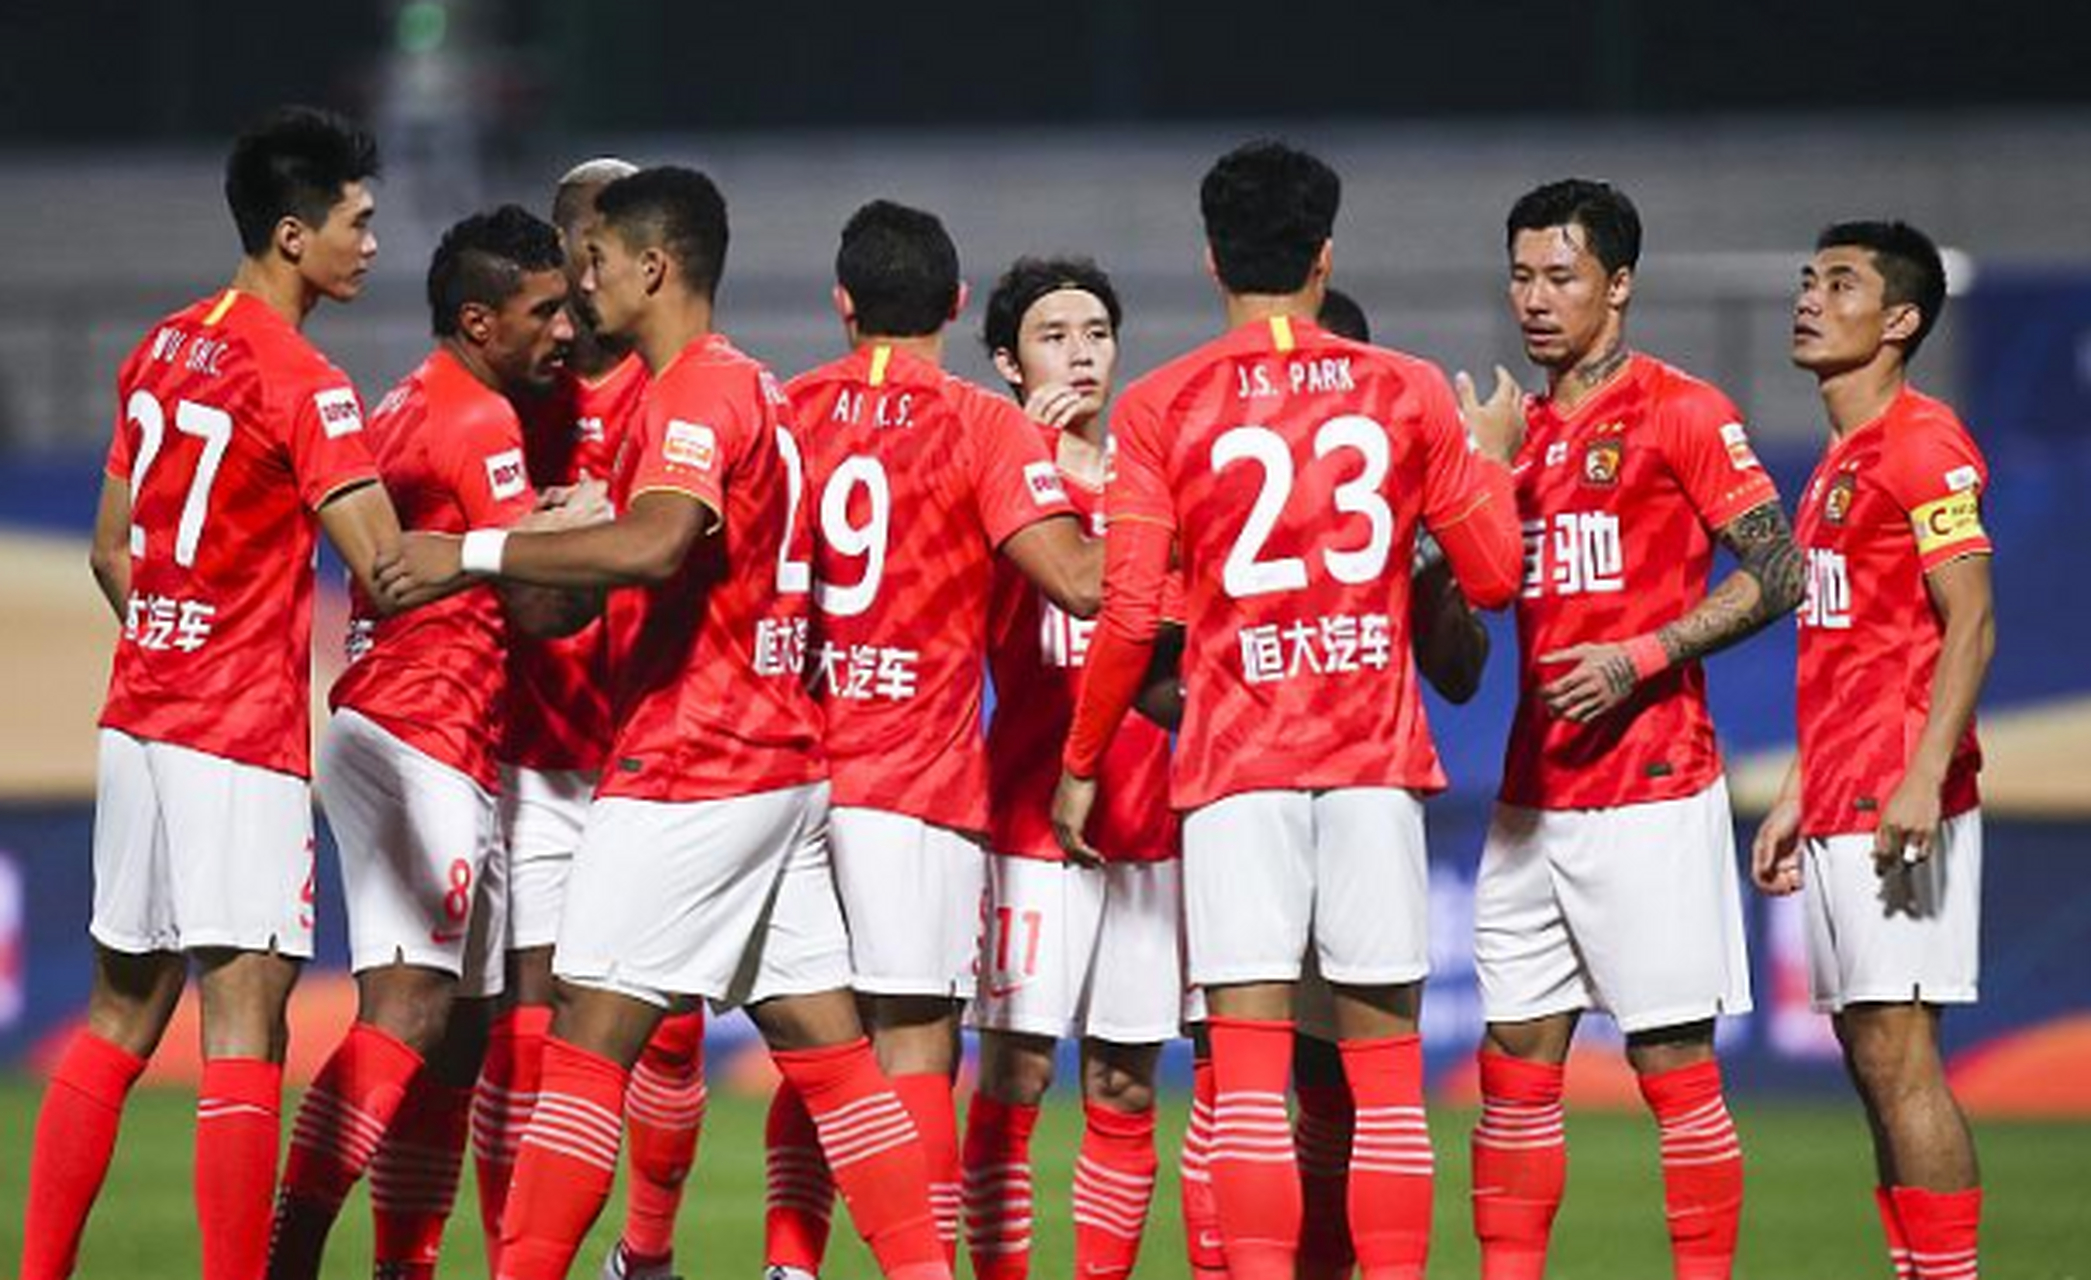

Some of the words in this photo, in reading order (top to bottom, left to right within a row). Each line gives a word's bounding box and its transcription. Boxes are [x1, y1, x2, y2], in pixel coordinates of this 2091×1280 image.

[1238, 364, 1279, 398] J.S.
[1289, 356, 1356, 395] PARK
[126, 389, 233, 567] 27
[1210, 414, 1394, 599] 23
[814, 454, 891, 617] 9
[1928, 505, 1953, 537] C
[1238, 613, 1390, 686] 恒大汽车
[443, 858, 472, 923] 8
[996, 905, 1042, 976] 11
